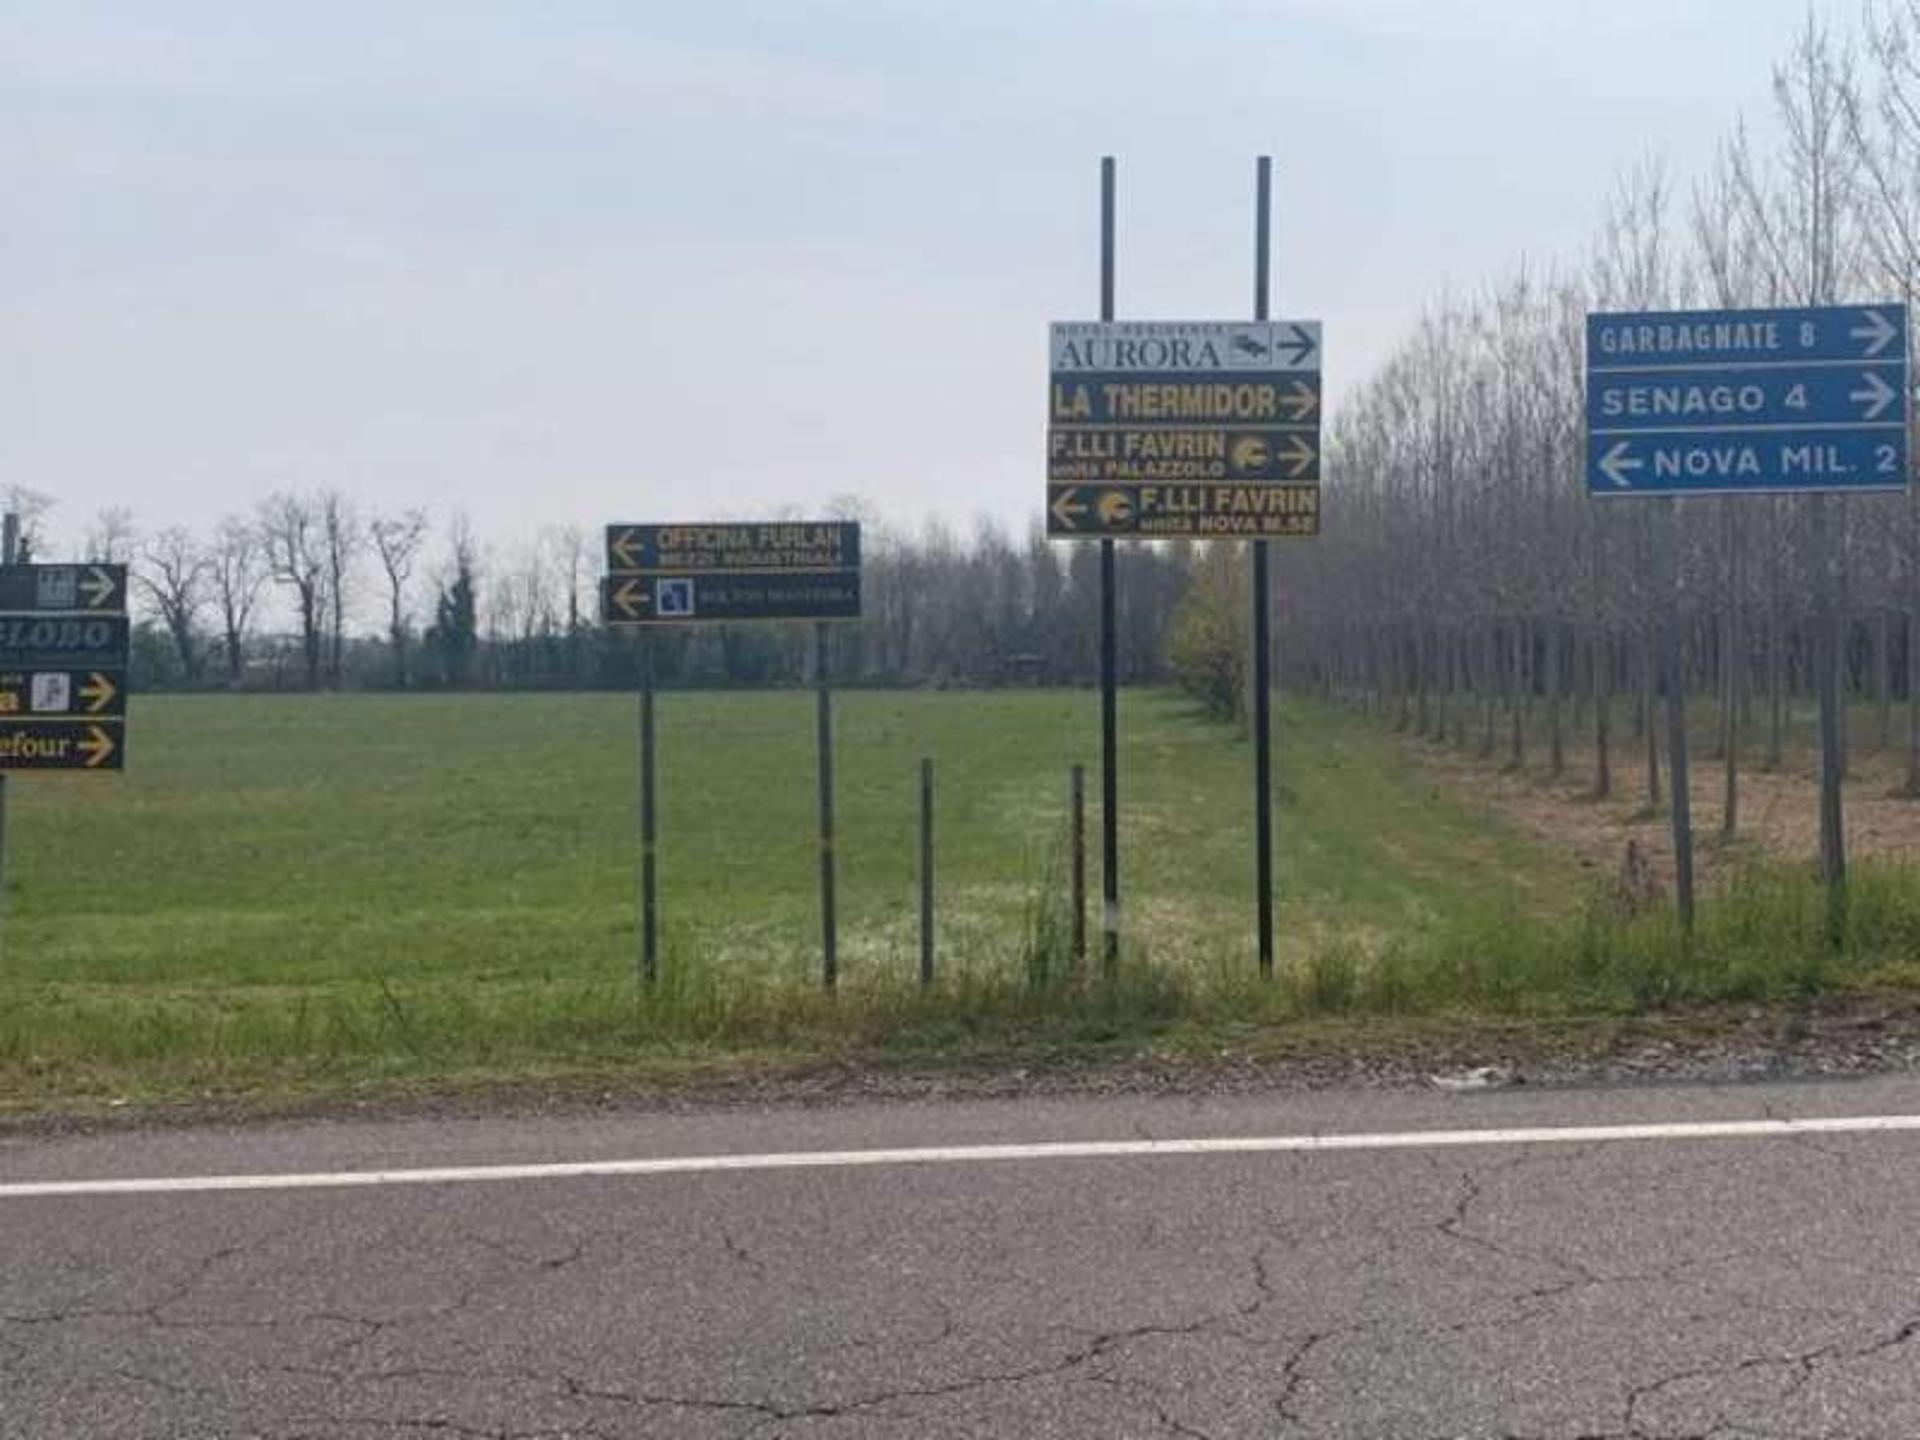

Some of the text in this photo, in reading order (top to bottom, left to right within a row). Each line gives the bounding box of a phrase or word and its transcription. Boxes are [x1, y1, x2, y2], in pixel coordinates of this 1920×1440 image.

[1600, 320, 1816, 353] GARBAGNATE 8
[1057, 338, 1222, 368] AURORA
[1053, 383, 1276, 417] LA THERMIDOR
[1601, 384, 1807, 416] SENAGO 4
[1052, 431, 1227, 458] F.LLI FAVRIN
[1103, 459, 1227, 478] PALAZZOLO
[1654, 444, 1898, 478] NOVA MIL. 2
[1139, 487, 1318, 514] F.LLI FAVRIN
[1199, 514, 1253, 532] NOVA
